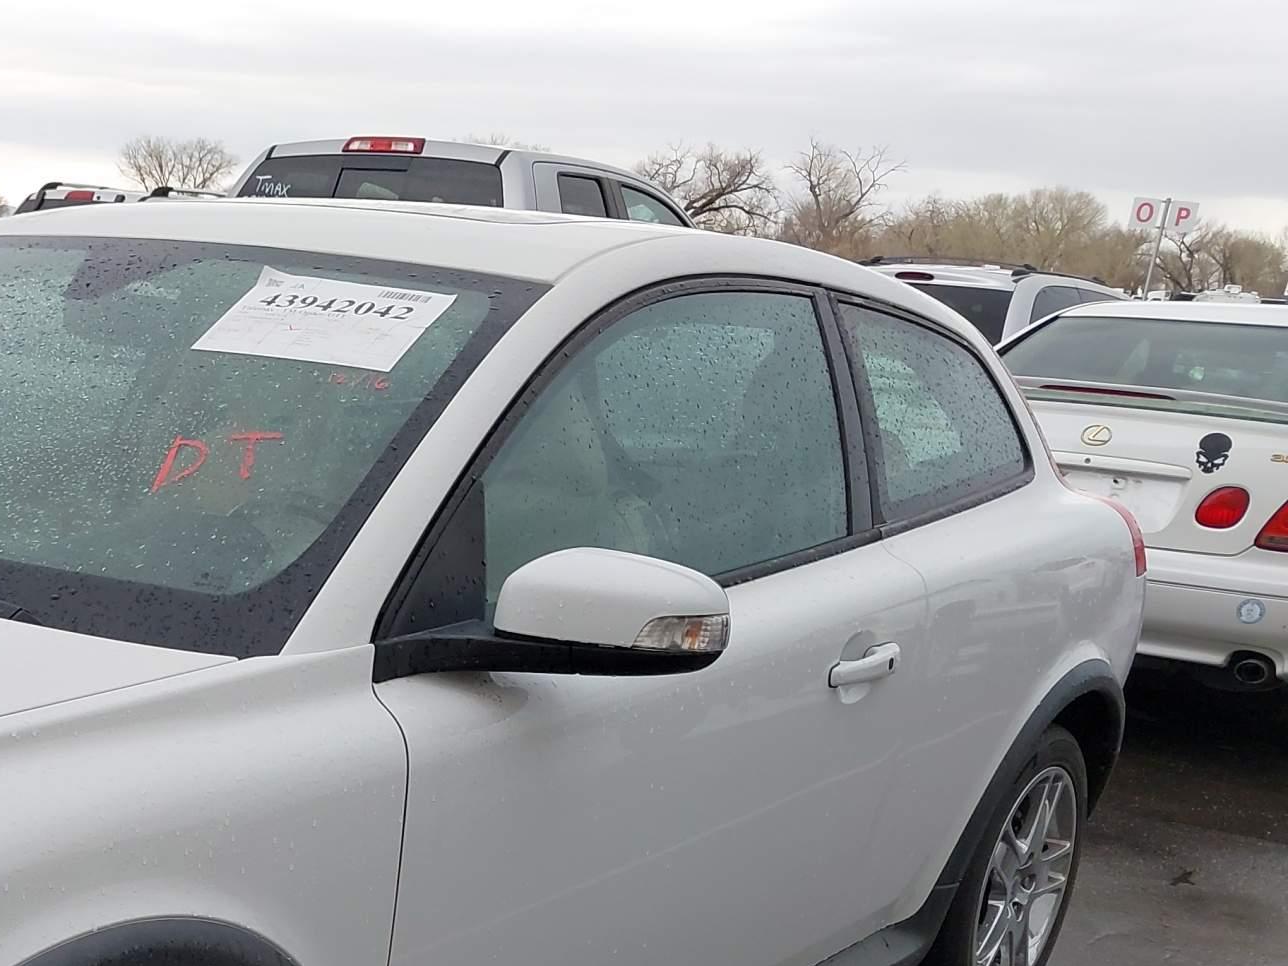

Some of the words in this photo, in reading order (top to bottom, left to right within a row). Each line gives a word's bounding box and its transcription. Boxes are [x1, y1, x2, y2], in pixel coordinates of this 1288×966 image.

[1136, 203, 1154, 223] O
[1175, 207, 1191, 226] P
[259, 293, 414, 320] 43942042
